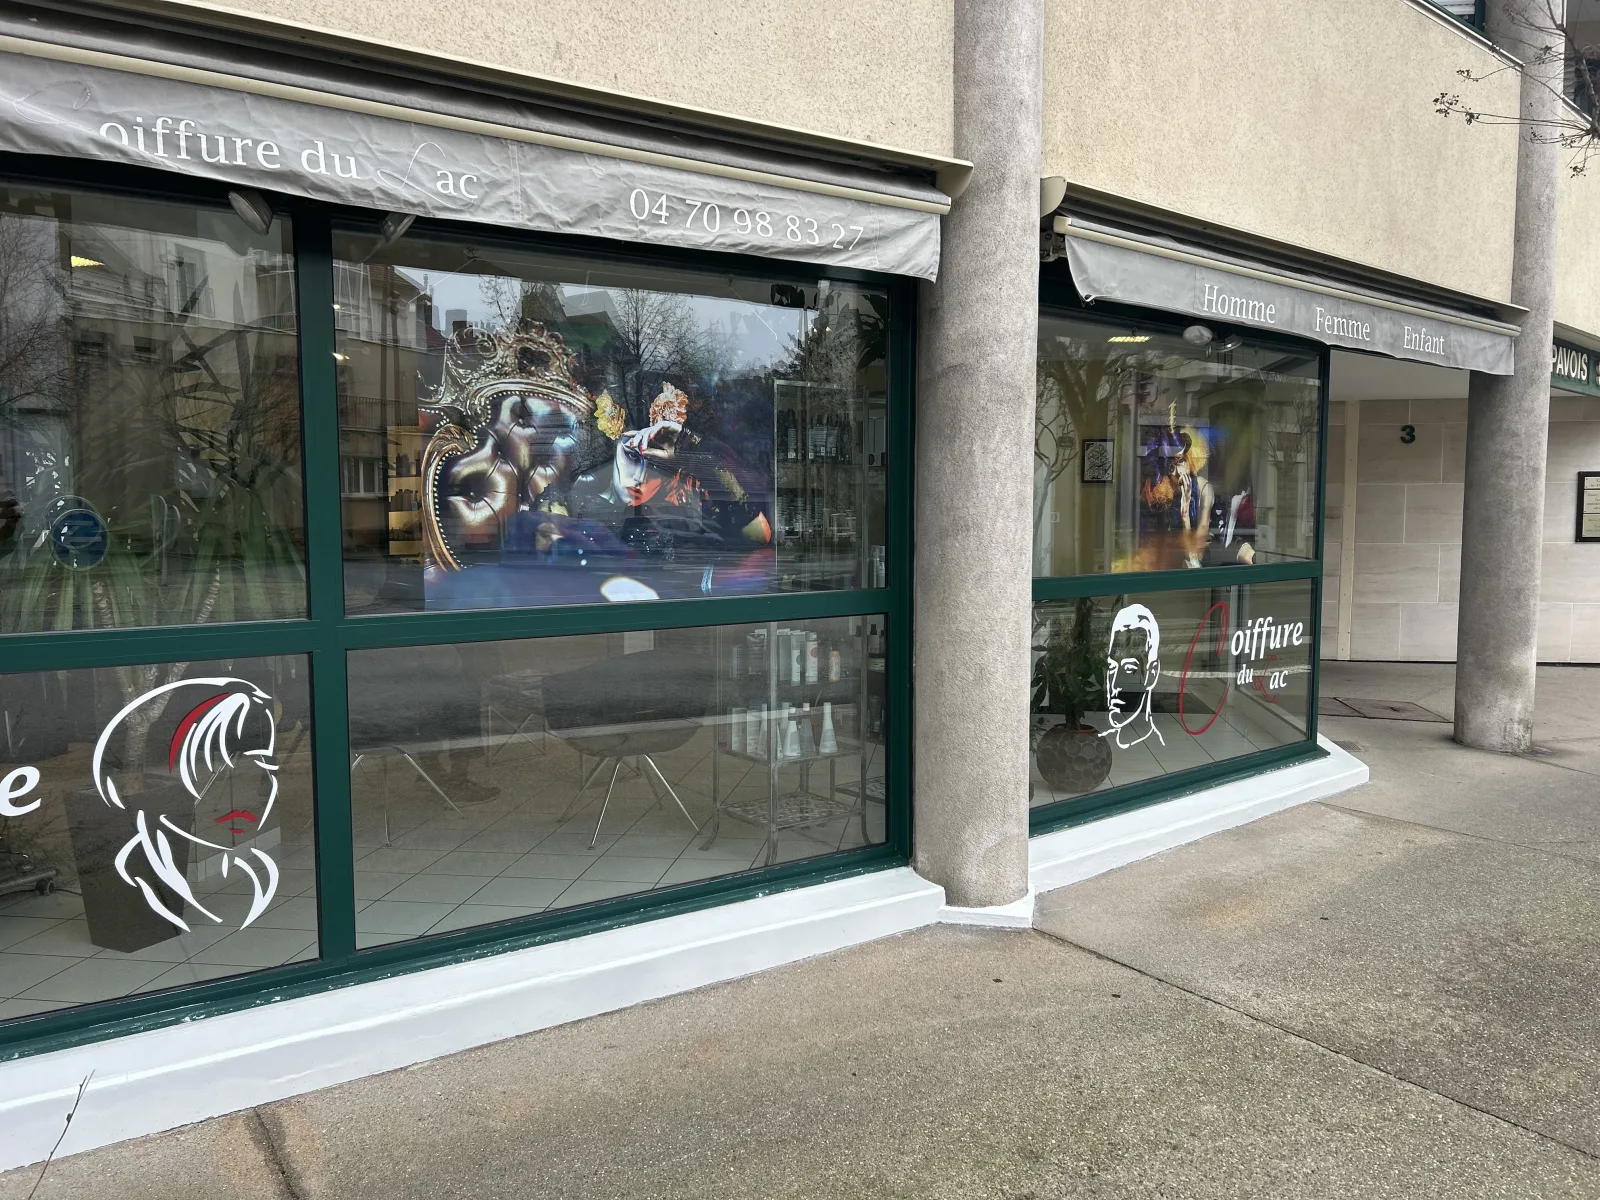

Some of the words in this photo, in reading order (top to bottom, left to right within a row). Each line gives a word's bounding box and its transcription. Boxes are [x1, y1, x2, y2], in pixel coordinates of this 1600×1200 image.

[301, 139, 362, 179] du
[629, 188, 669, 225] 04
[684, 199, 721, 232] 70
[733, 208, 774, 237] 98
[786, 214, 820, 245] 83
[831, 222, 864, 251] 27
[1202, 283, 1276, 324] Homme
[1315, 306, 1371, 342] Femme
[1403, 325, 1445, 356] Enfant
[1551, 344, 1588, 381] PAVOIS
[1400, 425, 1416, 444] 3
[1236, 663, 1254, 686] du
